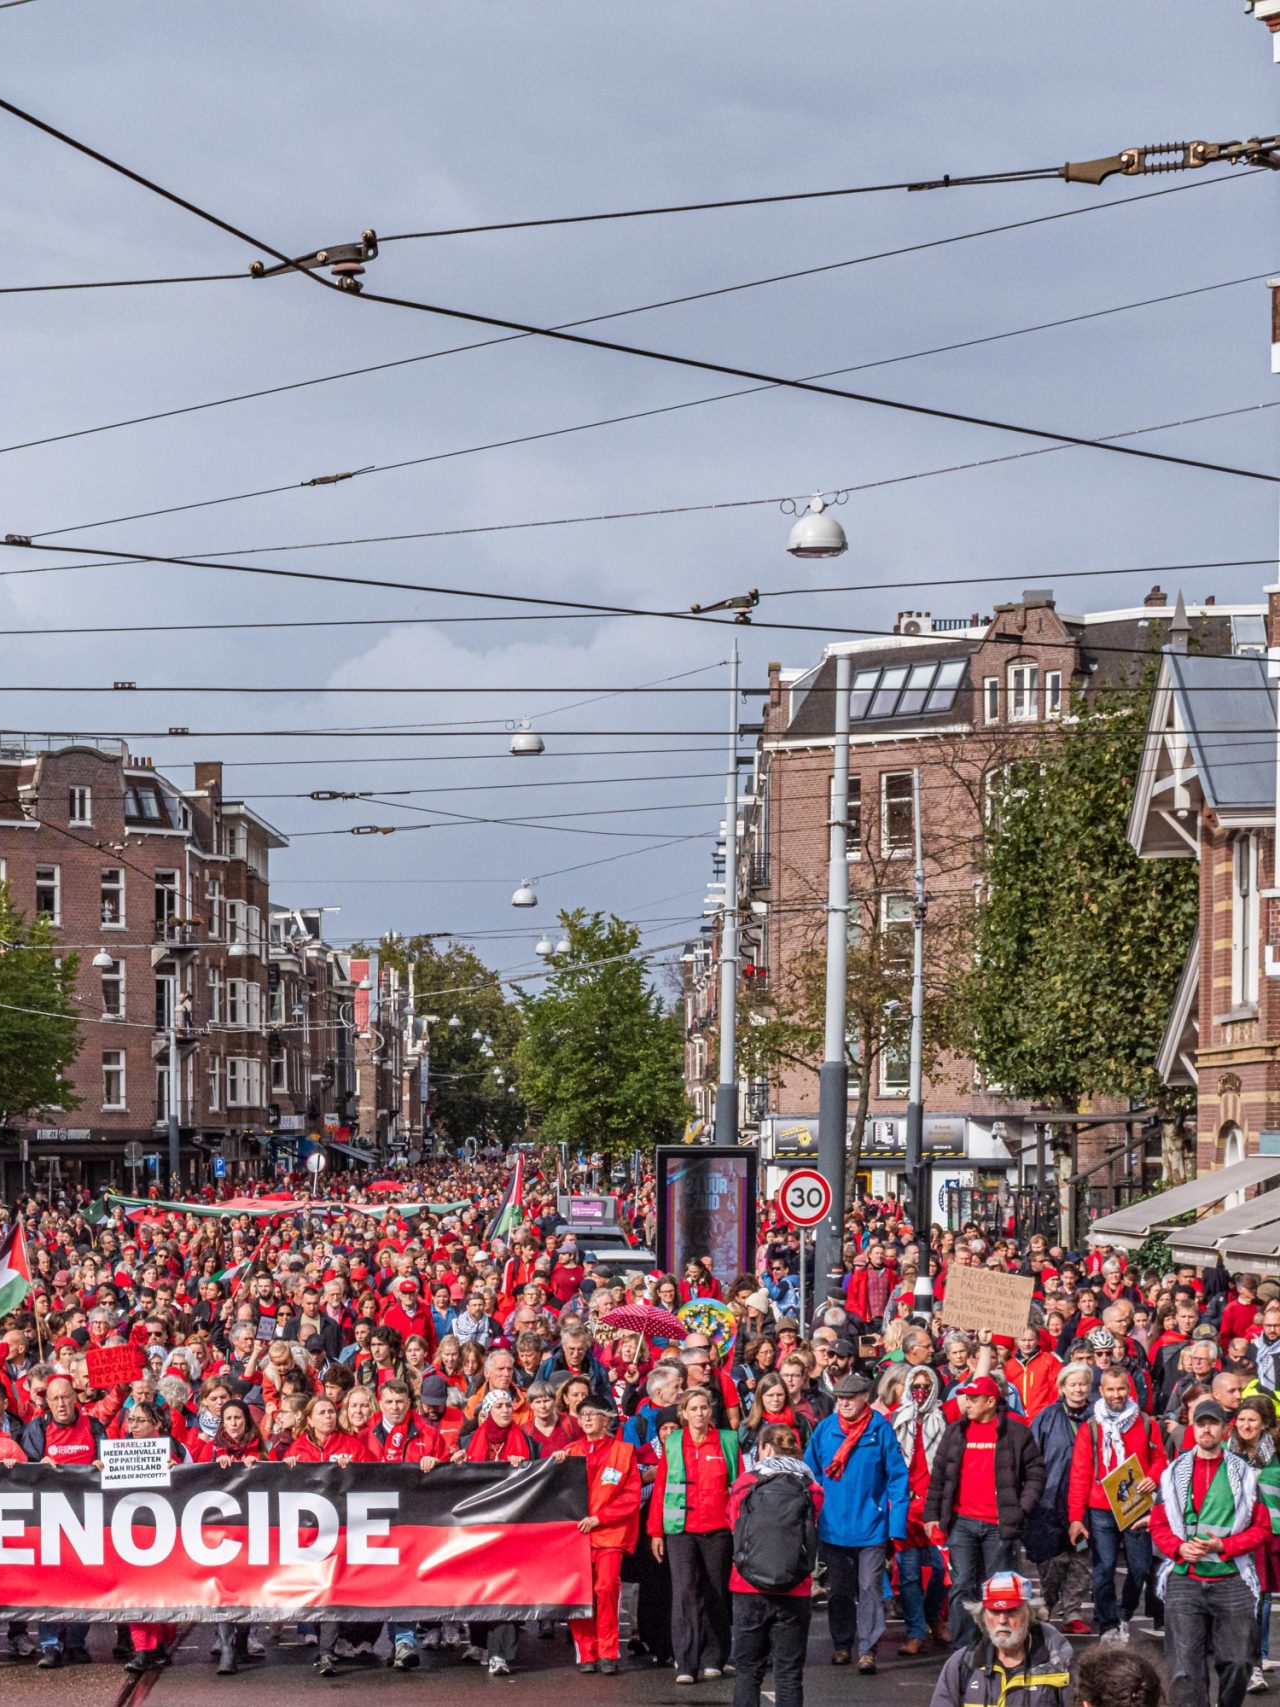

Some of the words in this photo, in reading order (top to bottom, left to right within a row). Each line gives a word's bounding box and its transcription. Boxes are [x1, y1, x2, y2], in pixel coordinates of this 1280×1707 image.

[216, 1159, 223, 1169] P
[703, 1177, 728, 1194] UUR
[790, 1187, 823, 1208] 30
[960, 1291, 996, 1306] SUPPORT
[999, 1300, 1017, 1311] THE
[945, 1299, 997, 1316] PALESTINIAN
[91, 1355, 132, 1367] GENOCIDE
[105, 1371, 137, 1383] GAZA
[113, 1441, 142, 1449] ISRAEL:
[124, 1448, 167, 1456] AANVALLEN
[120, 1455, 161, 1463] PATIËNTEN
[126, 1464, 162, 1472] RUSLAND
